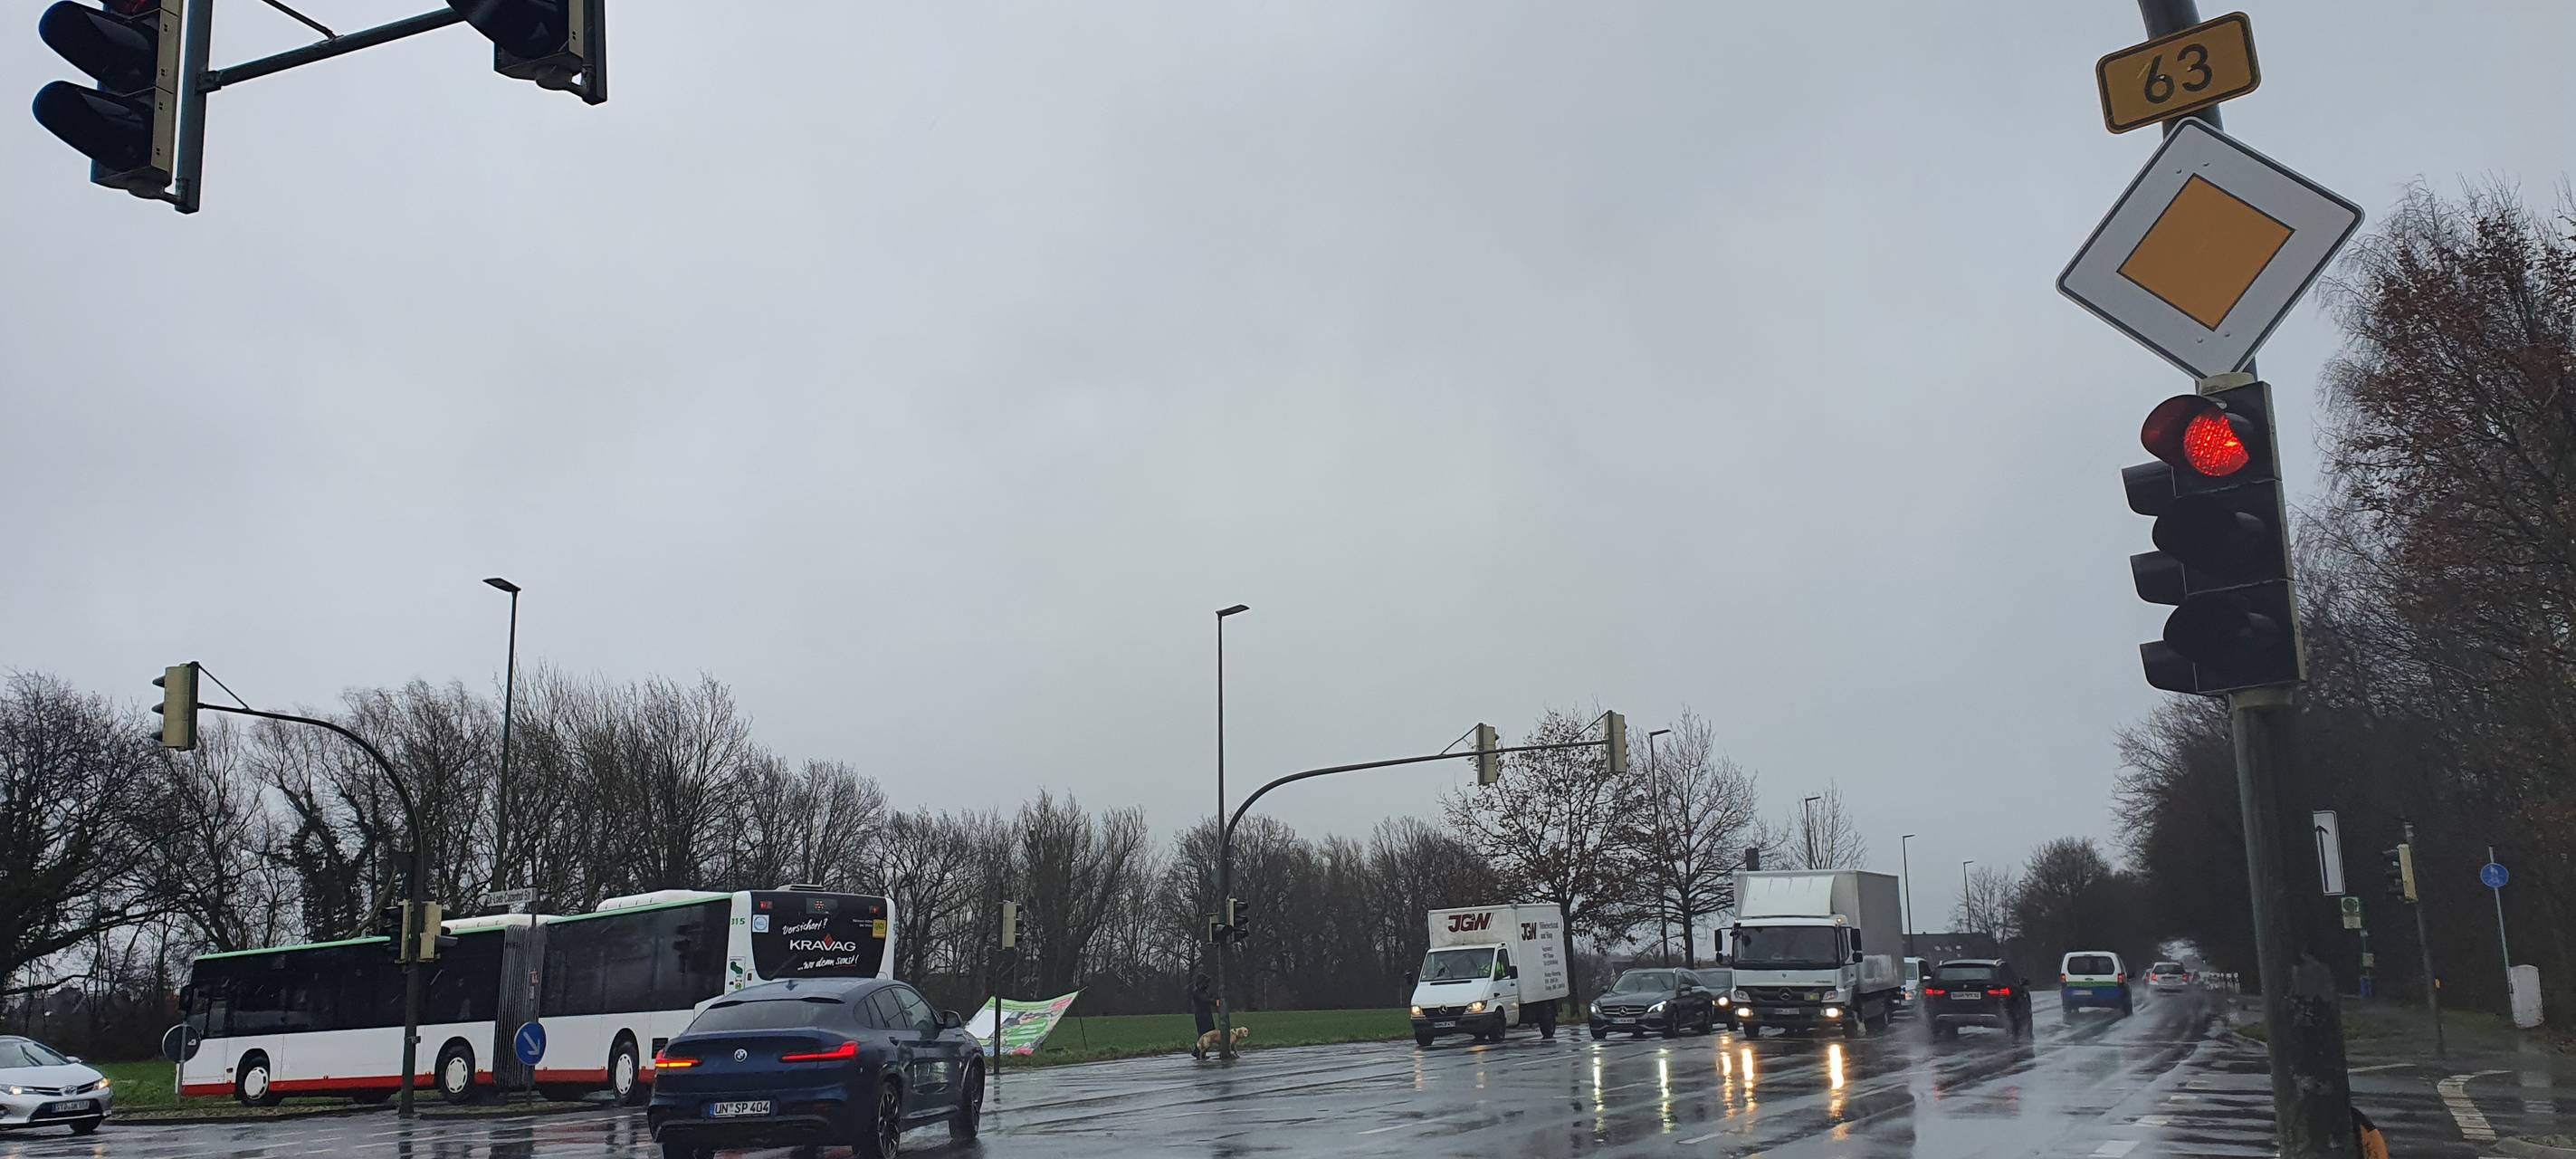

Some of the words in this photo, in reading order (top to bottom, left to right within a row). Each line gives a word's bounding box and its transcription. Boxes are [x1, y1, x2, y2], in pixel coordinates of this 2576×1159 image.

[2144, 43, 2212, 104] 63
[1448, 913, 1493, 933] JGW
[1522, 922, 1537, 941] JGW
[789, 940, 856, 952] KRAVAG
[715, 1104, 729, 1114] UN
[735, 1103, 749, 1113] SP
[749, 1102, 768, 1113] 404
